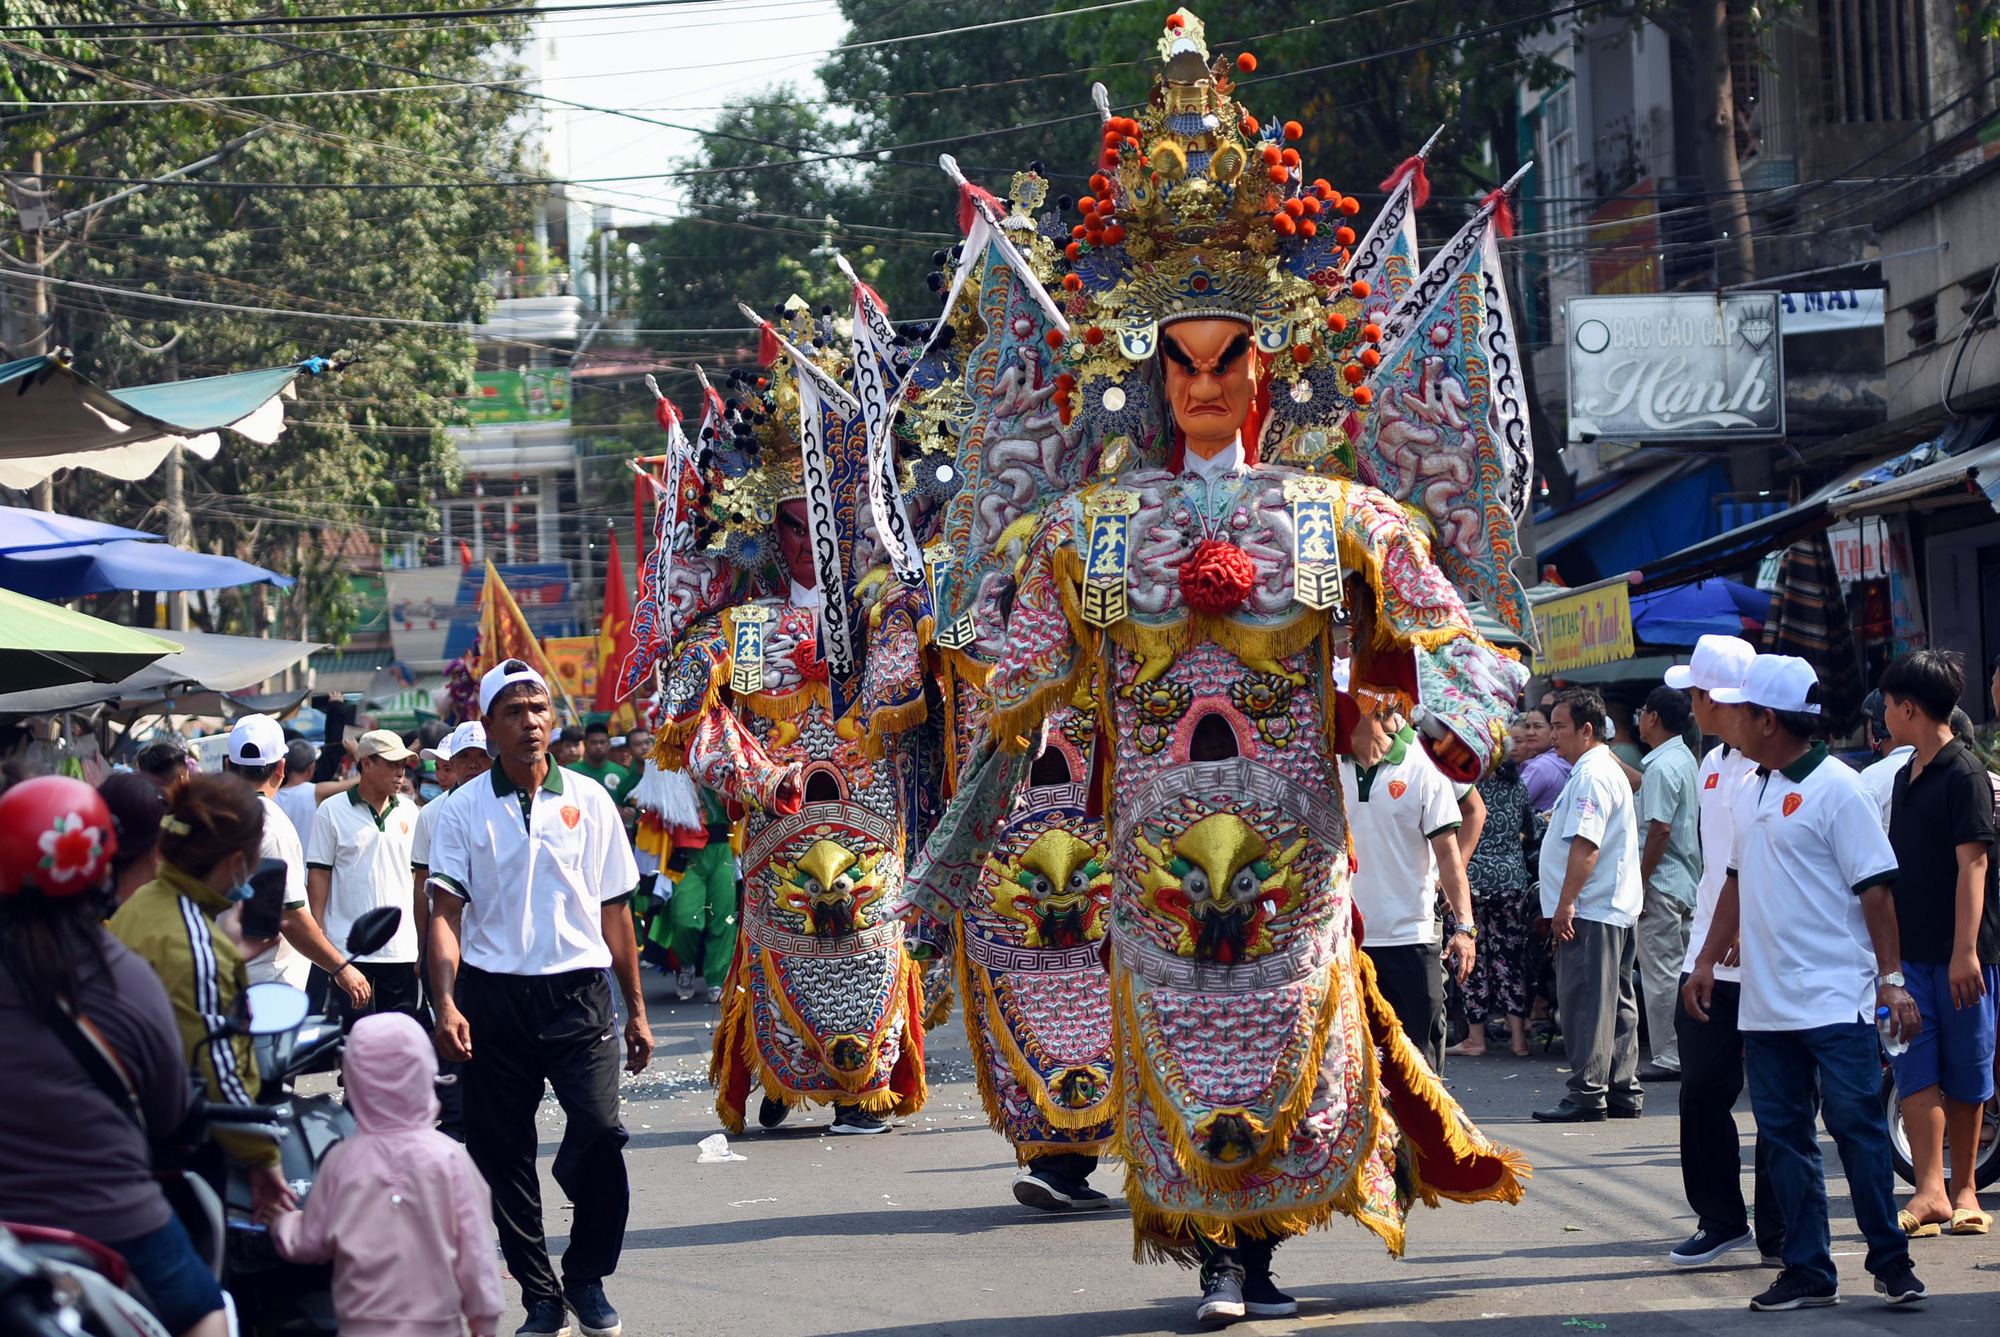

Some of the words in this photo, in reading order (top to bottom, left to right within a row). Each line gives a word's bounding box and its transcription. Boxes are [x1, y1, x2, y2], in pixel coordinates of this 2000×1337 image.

[1612, 317, 1651, 354] BẠC
[1656, 315, 1696, 347] CAO
[1587, 355, 1772, 430] Hạnh
